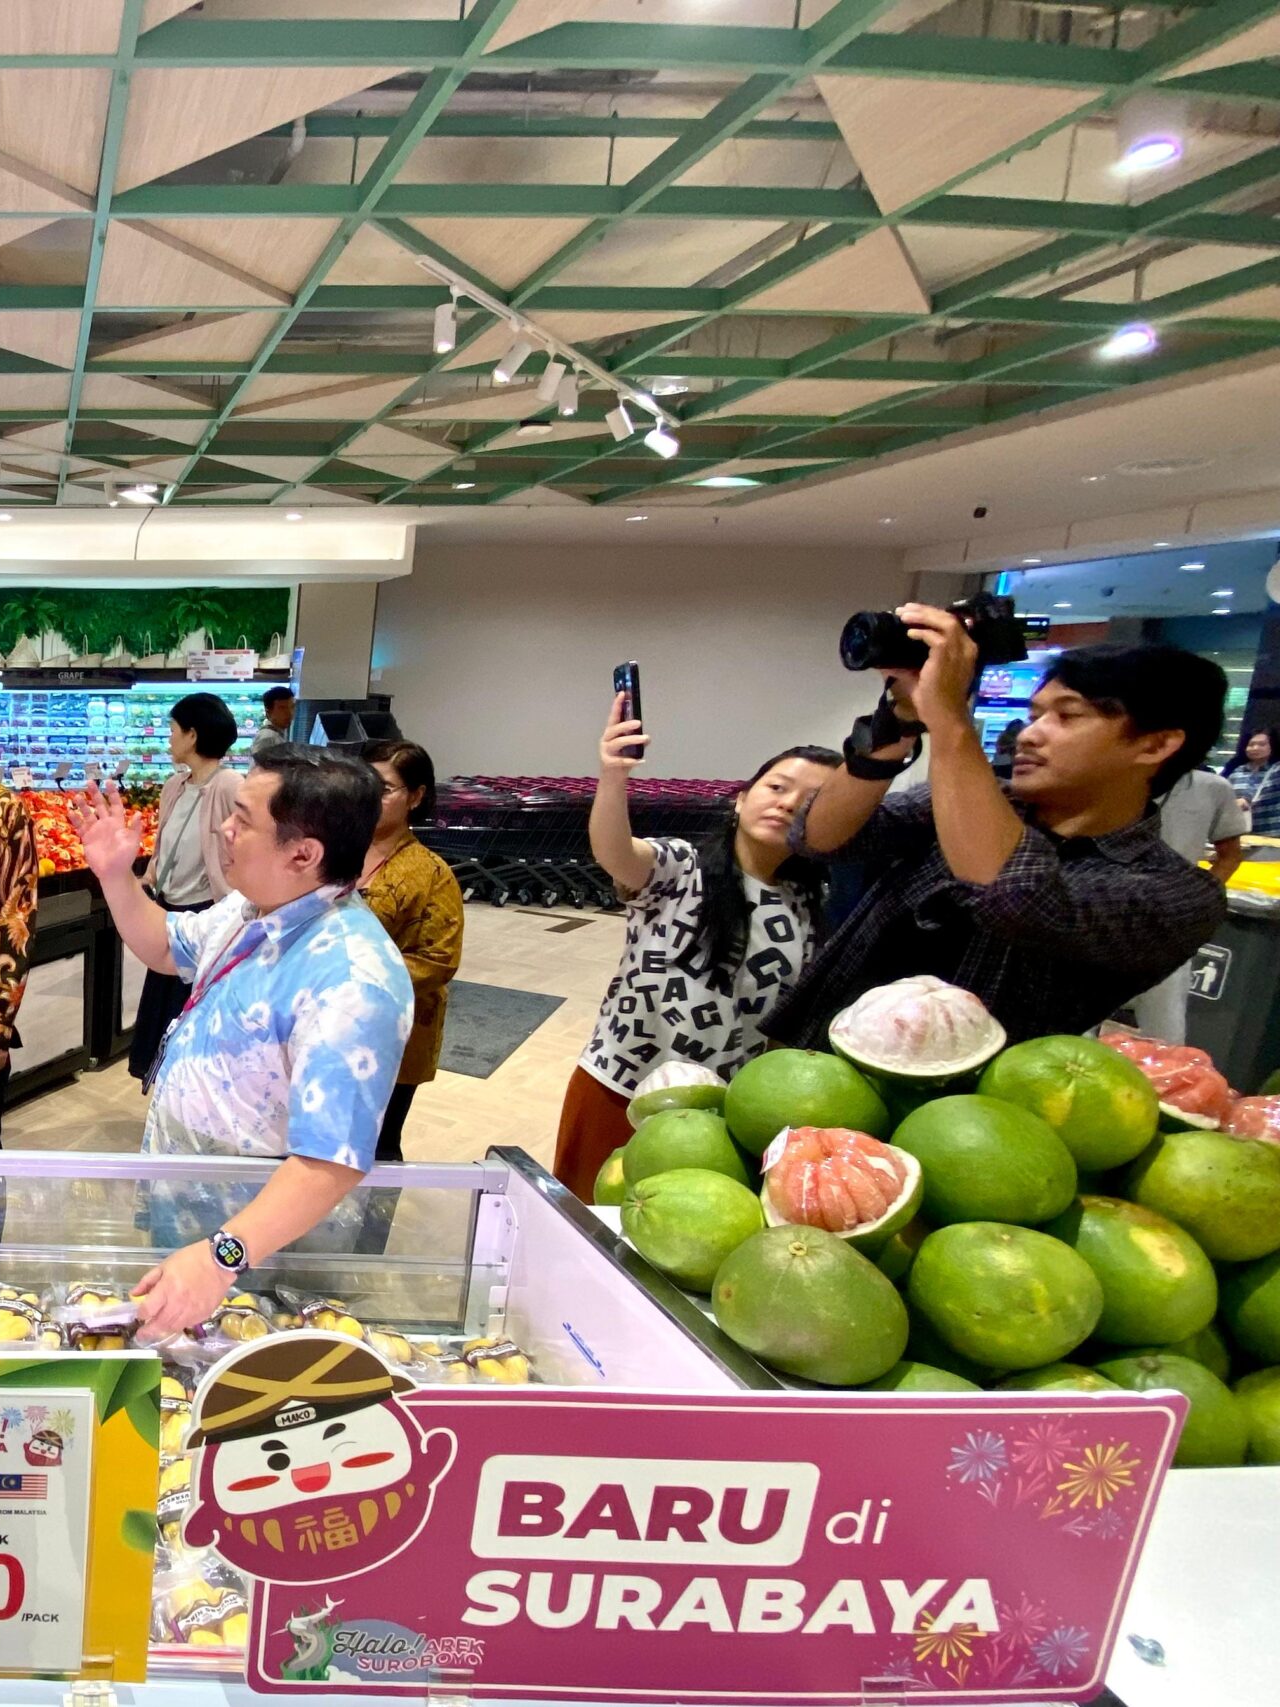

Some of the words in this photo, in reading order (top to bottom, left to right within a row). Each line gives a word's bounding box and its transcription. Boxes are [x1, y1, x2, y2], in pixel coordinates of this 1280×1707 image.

[58, 671, 85, 680] GRAPE
[281, 1409, 312, 1425] MAKO
[497, 1481, 791, 1545] BARU
[824, 1498, 892, 1545] di
[294, 1506, 359, 1555] 福
[461, 1569, 1001, 1635] SURABAYA
[21, 1612, 60, 1623] /PACK
[332, 1631, 422, 1657] Halo!
[423, 1637, 485, 1656] AREK
[356, 1652, 483, 1674] SUROBOYO
